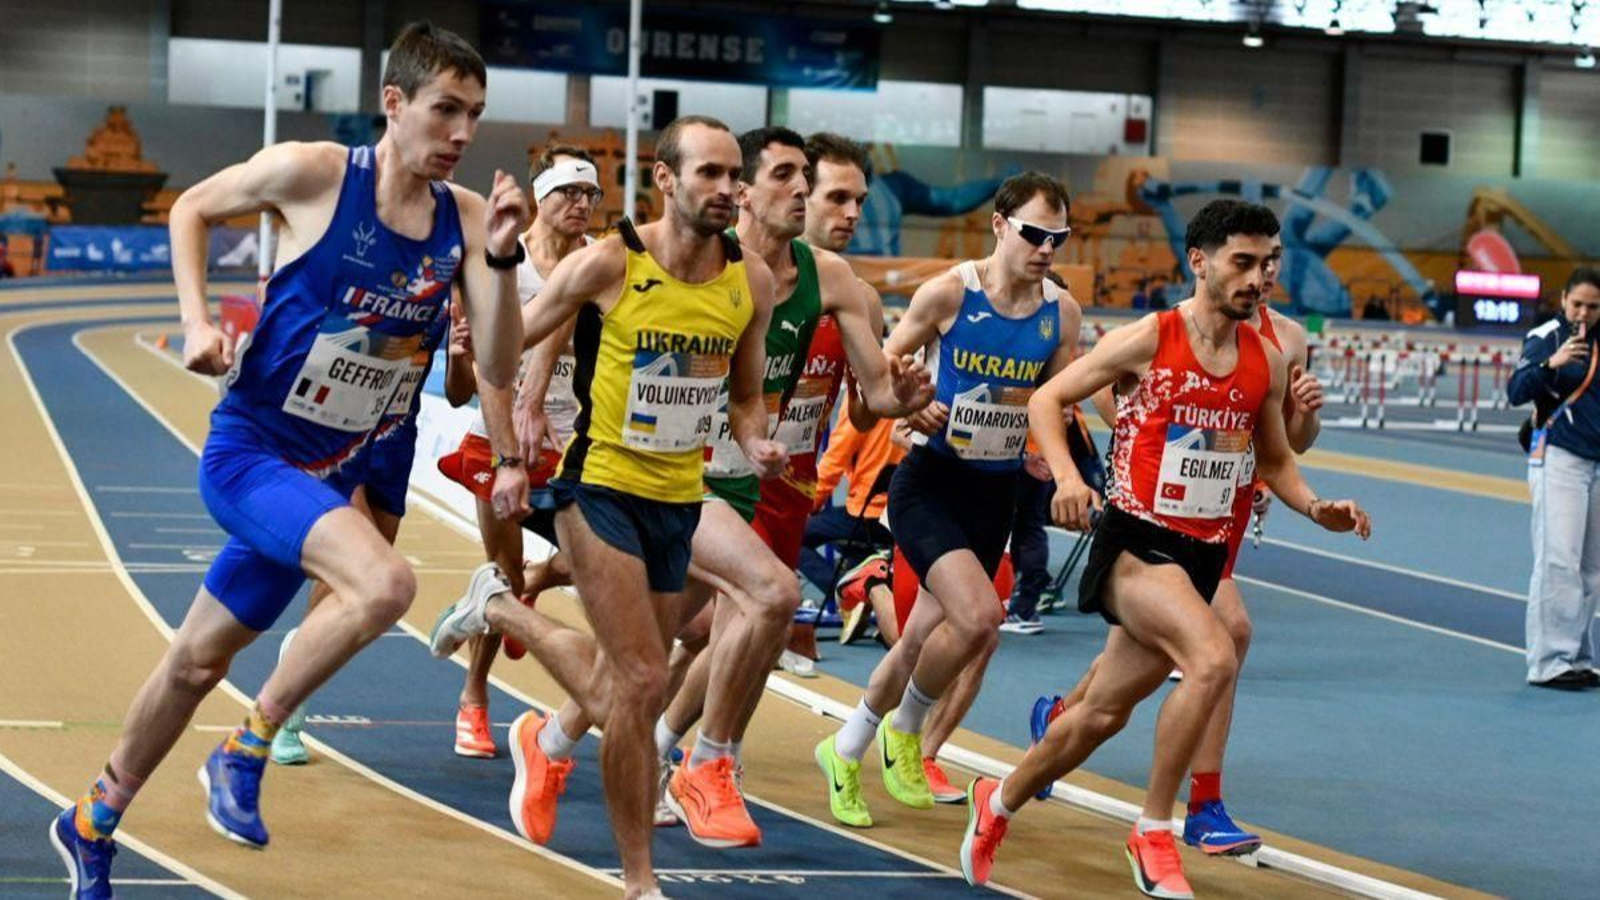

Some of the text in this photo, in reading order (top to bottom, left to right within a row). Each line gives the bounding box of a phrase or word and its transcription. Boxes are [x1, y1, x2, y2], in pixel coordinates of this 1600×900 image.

[359, 290, 436, 322] FRANCE
[637, 331, 734, 356] UKRAINE
[328, 356, 400, 391] GEFFROY
[1172, 402, 1250, 430] TÜRKİYE
[1180, 457, 1235, 480] EGILMEZ
